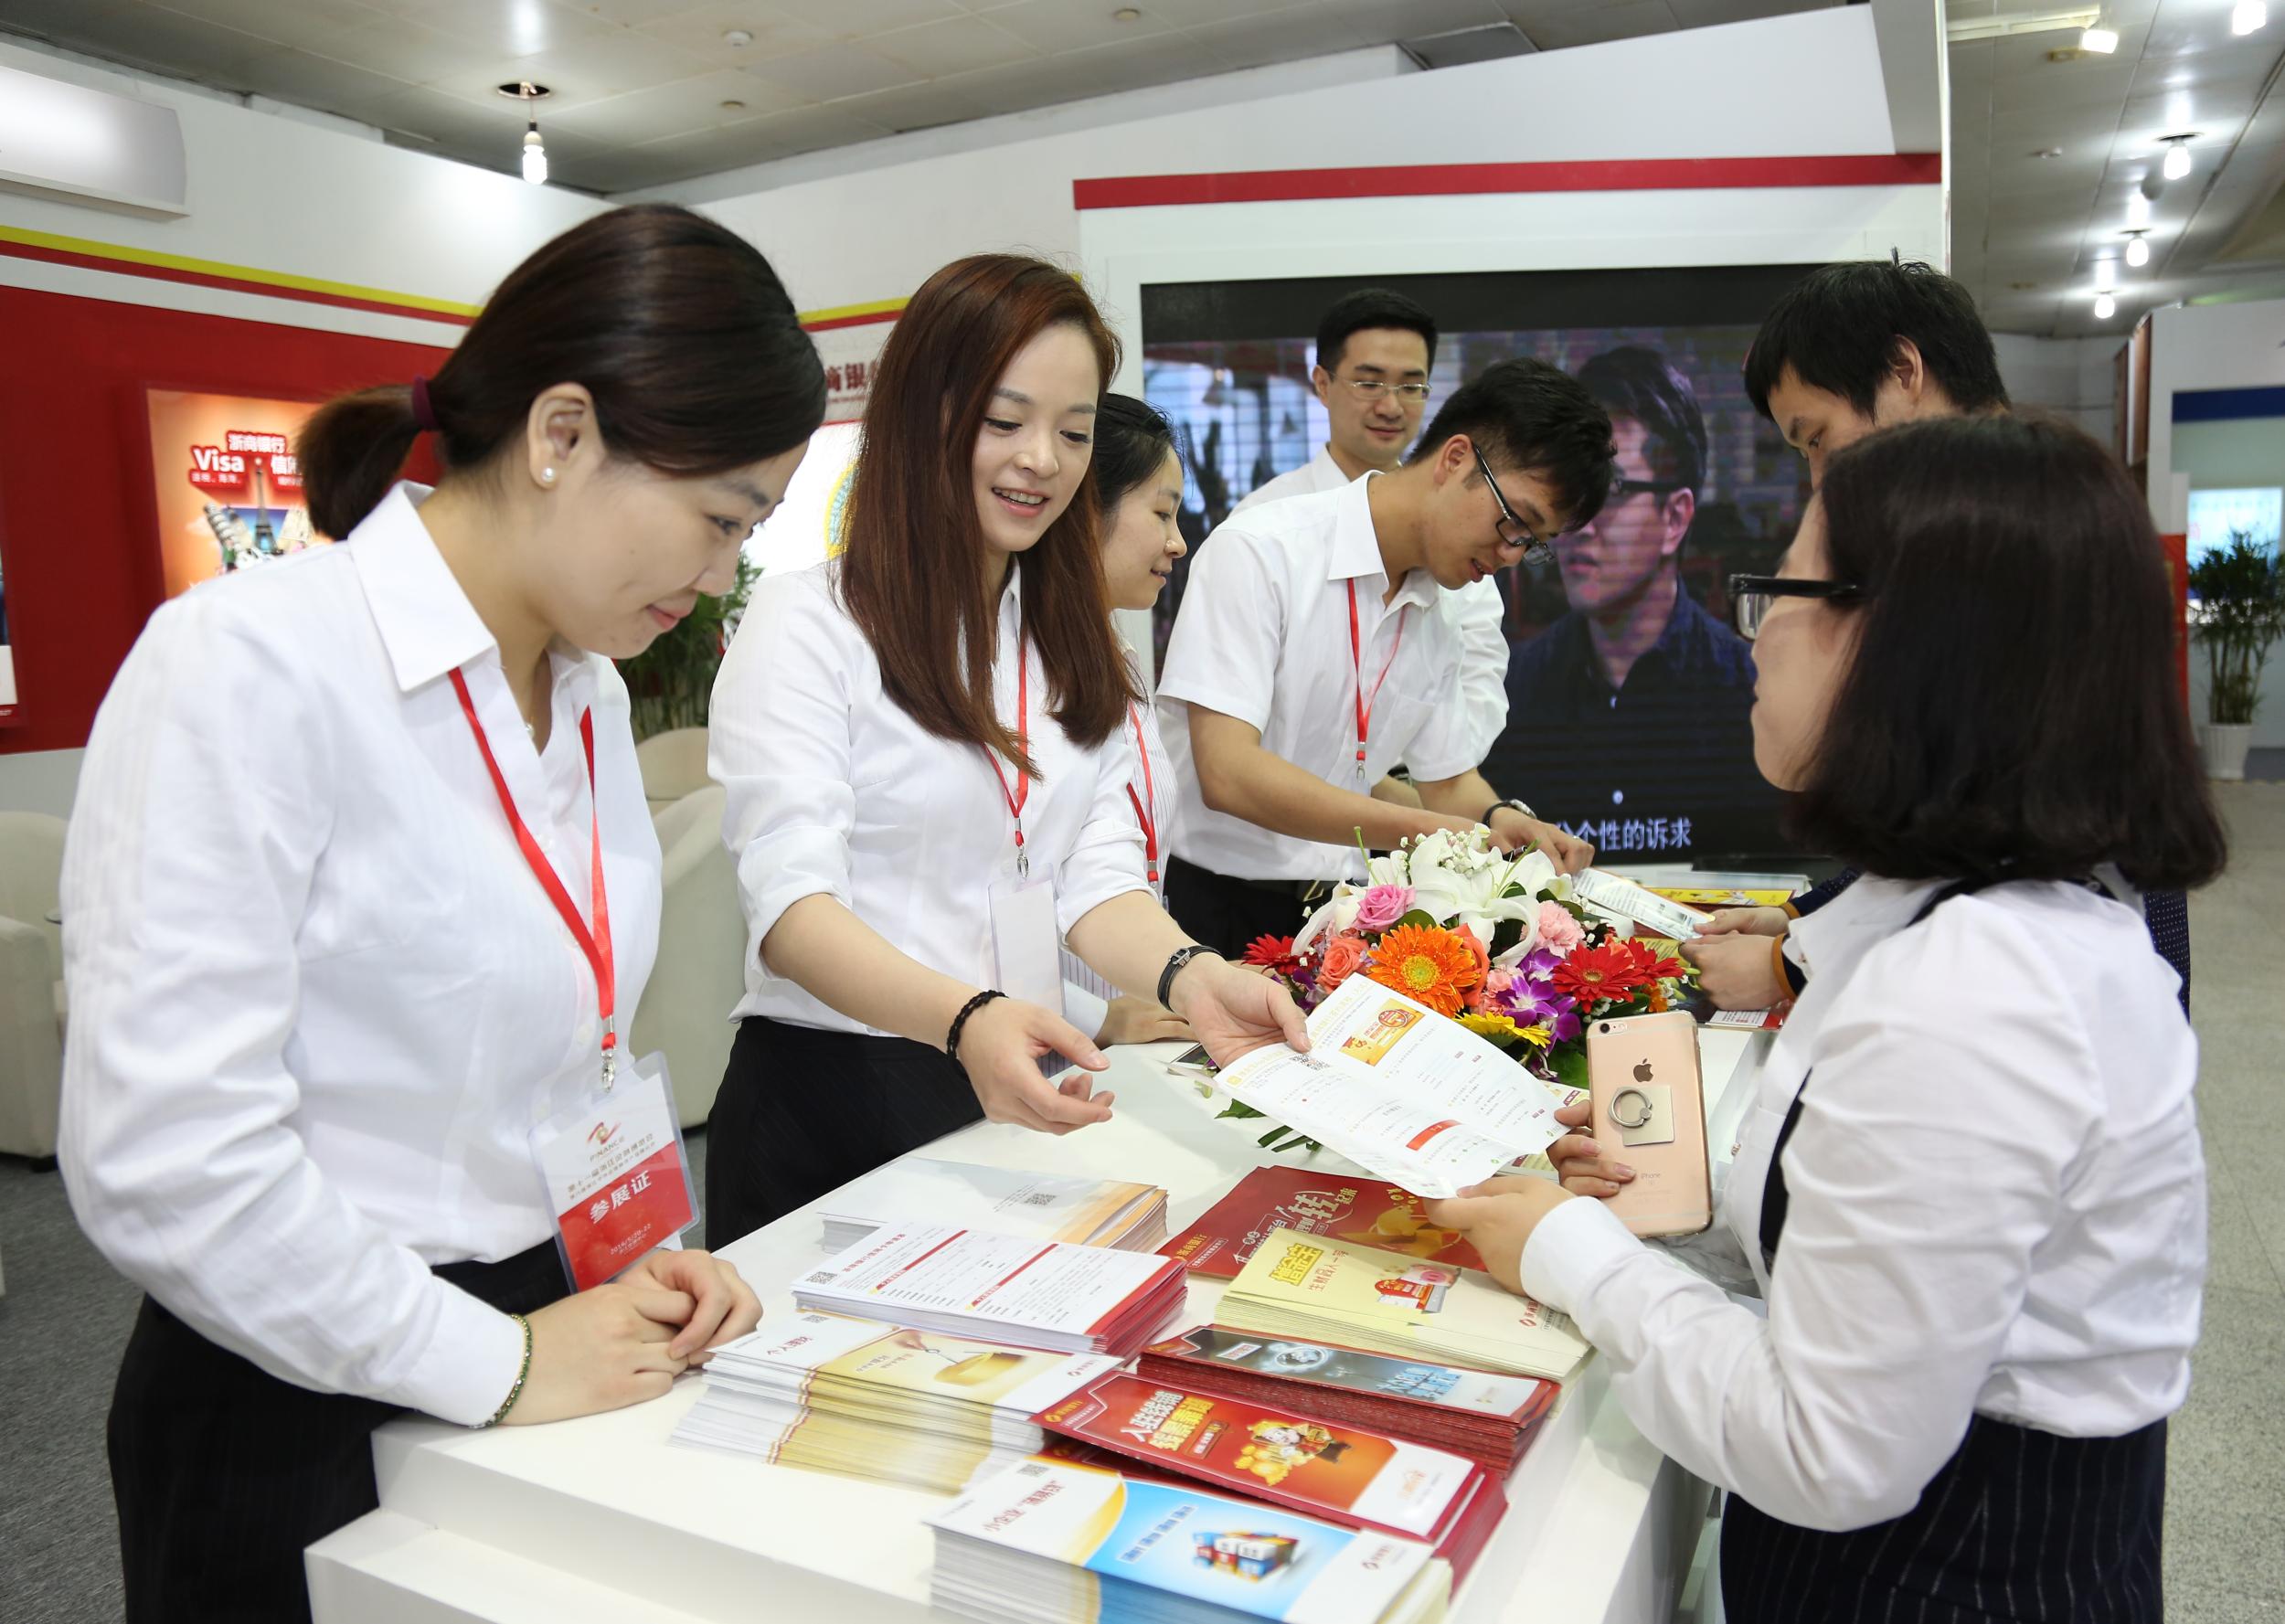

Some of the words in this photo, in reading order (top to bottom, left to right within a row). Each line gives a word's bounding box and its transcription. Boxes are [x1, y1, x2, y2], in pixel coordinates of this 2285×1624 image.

[194, 448, 245, 472] Visa
[590, 1170, 652, 1225] 参展证
